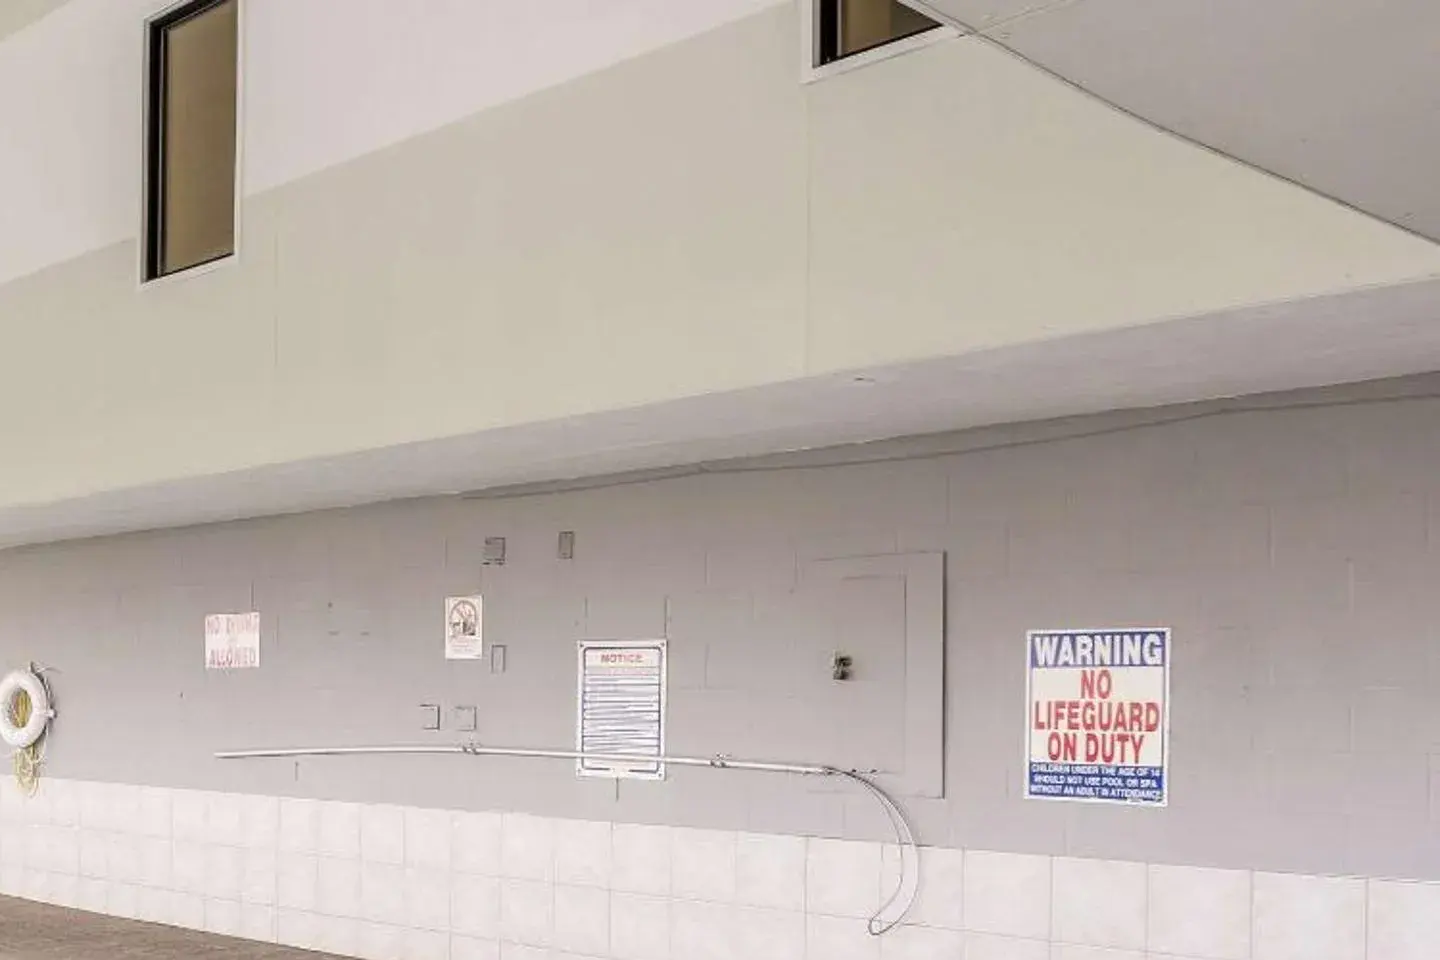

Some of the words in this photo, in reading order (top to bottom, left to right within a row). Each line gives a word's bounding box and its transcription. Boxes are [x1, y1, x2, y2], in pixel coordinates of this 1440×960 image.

[600, 653, 644, 664] NOTICE
[1035, 634, 1163, 666] WARNING
[1081, 669, 1112, 699] NO
[1034, 701, 1160, 732] LIFEGUARD
[1048, 732, 1077, 761] ON
[1086, 733, 1144, 763] DUTY
[1031, 763, 1070, 774] CHILDREN
[1071, 765, 1099, 775] UNDER
[1101, 766, 1116, 776] THE
[1118, 767, 1136, 777] AGE
[1137, 768, 1149, 777] OF
[1063, 785, 1075, 795] AN
[1076, 786, 1100, 797] ADULT
[1067, 776, 1083, 785] NOT
[1084, 777, 1101, 787] USE
[1102, 778, 1124, 788] POOL
[1126, 779, 1138, 788] OR
